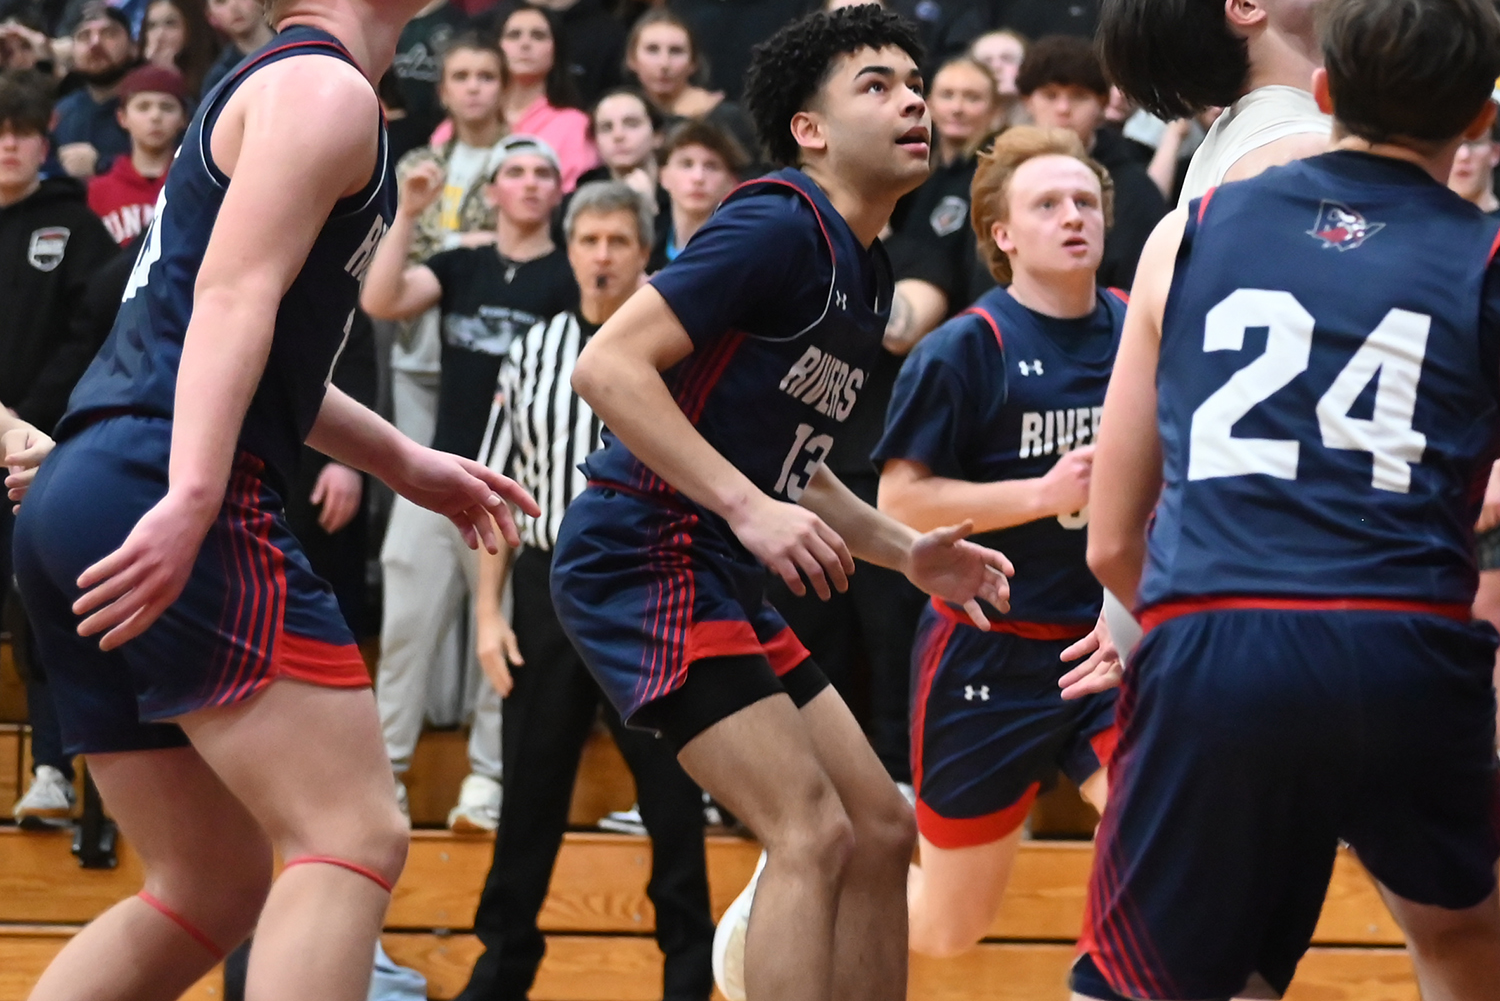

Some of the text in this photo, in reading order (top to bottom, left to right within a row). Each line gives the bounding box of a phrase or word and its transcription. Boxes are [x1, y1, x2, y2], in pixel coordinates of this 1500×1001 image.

[779, 344, 864, 422] RIVERS
[1187, 287, 1433, 494] 24
[774, 423, 834, 501] 13
